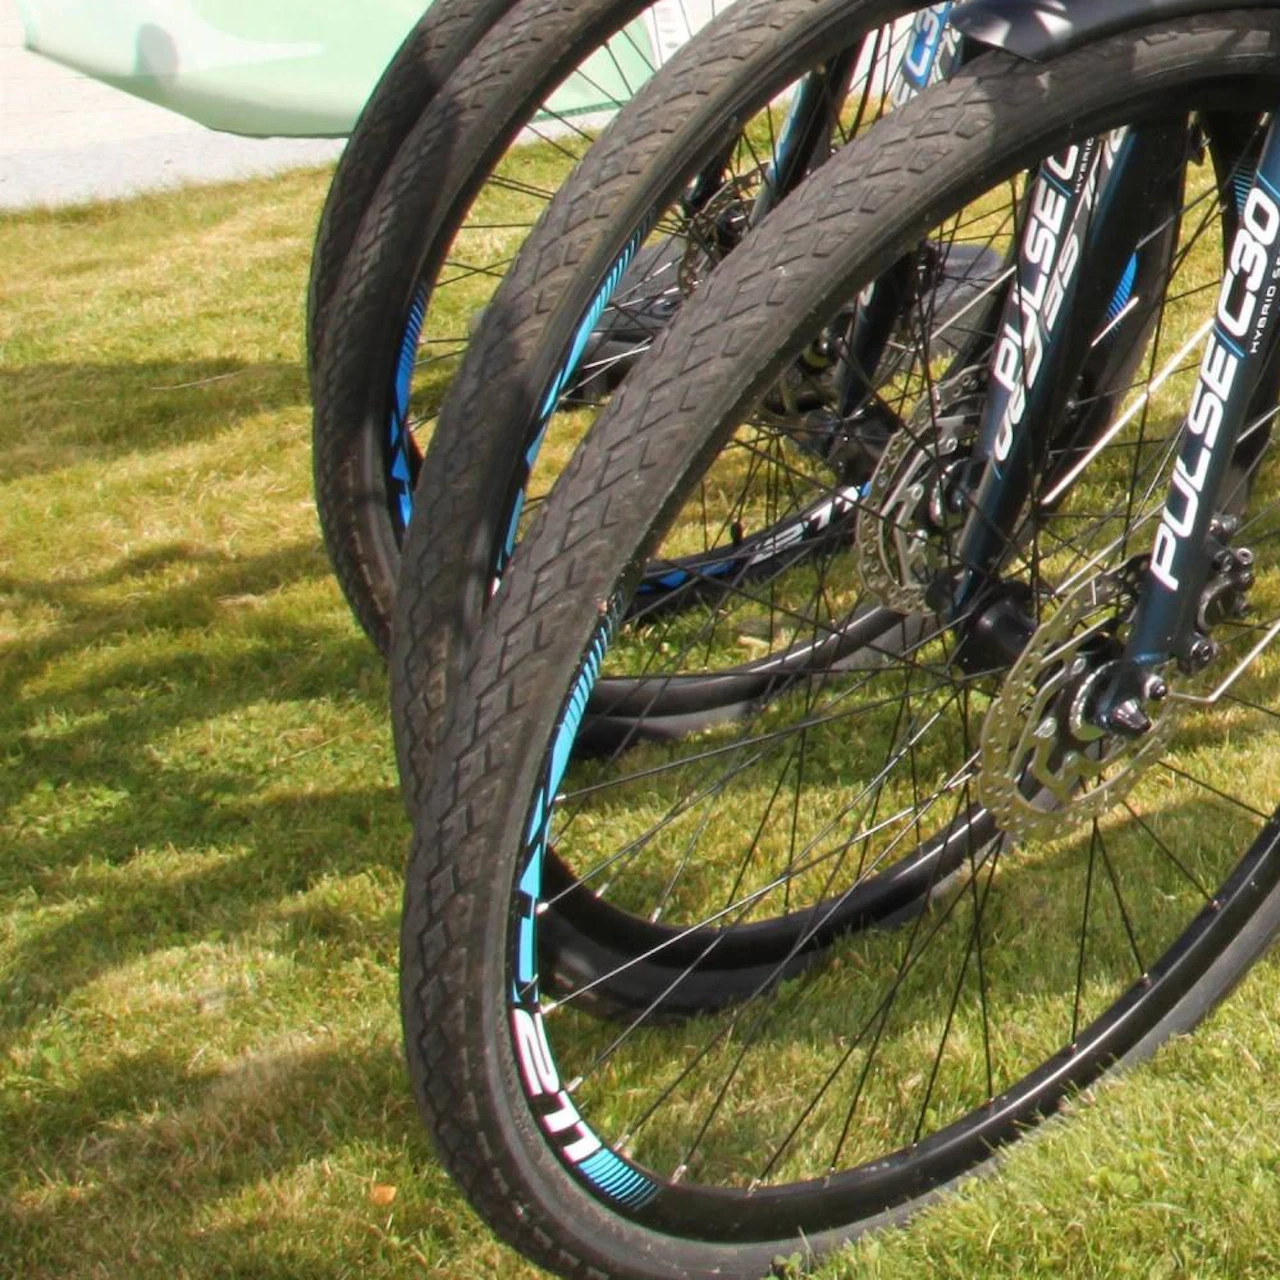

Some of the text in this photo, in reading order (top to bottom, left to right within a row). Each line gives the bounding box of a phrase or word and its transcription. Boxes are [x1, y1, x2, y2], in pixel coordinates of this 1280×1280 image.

[994, 185, 1066, 392] PULSE
[1249, 285, 1279, 355] HYBRID
[1149, 344, 1239, 591] PULSE
